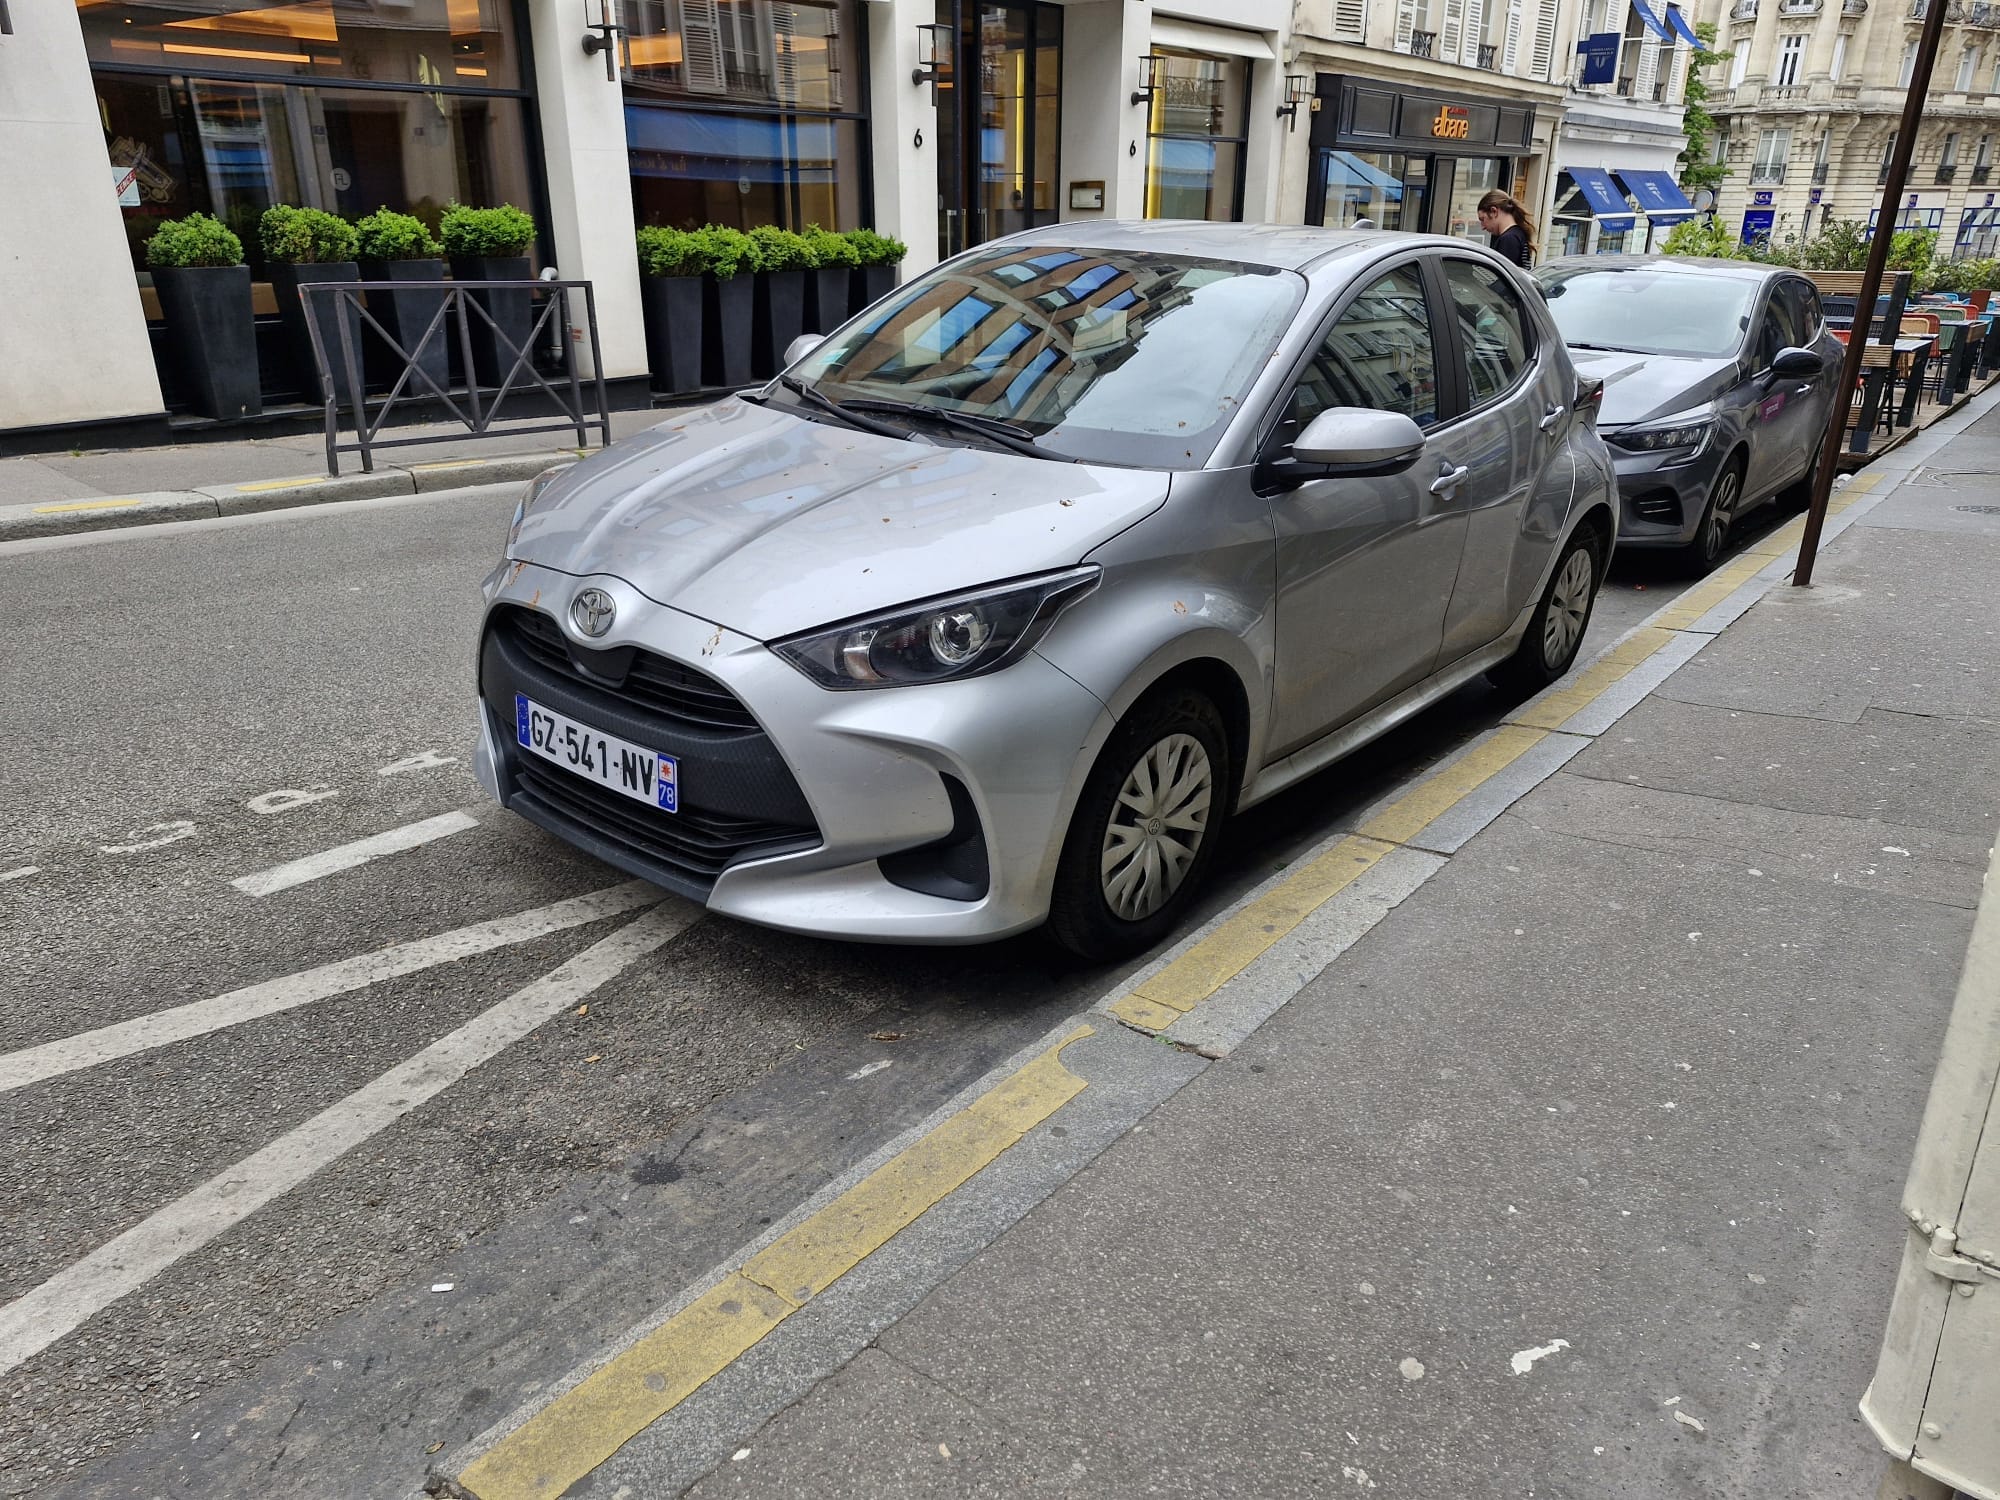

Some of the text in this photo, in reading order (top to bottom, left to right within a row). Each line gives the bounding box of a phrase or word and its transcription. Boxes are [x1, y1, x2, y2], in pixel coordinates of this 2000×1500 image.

[1433, 105, 1469, 139] albane
[913, 128, 923, 150] 6
[1129, 139, 1137, 157] 6
[521, 725, 527, 735] F
[531, 710, 654, 796] GZ-541-NV
[659, 784, 675, 804] 78
